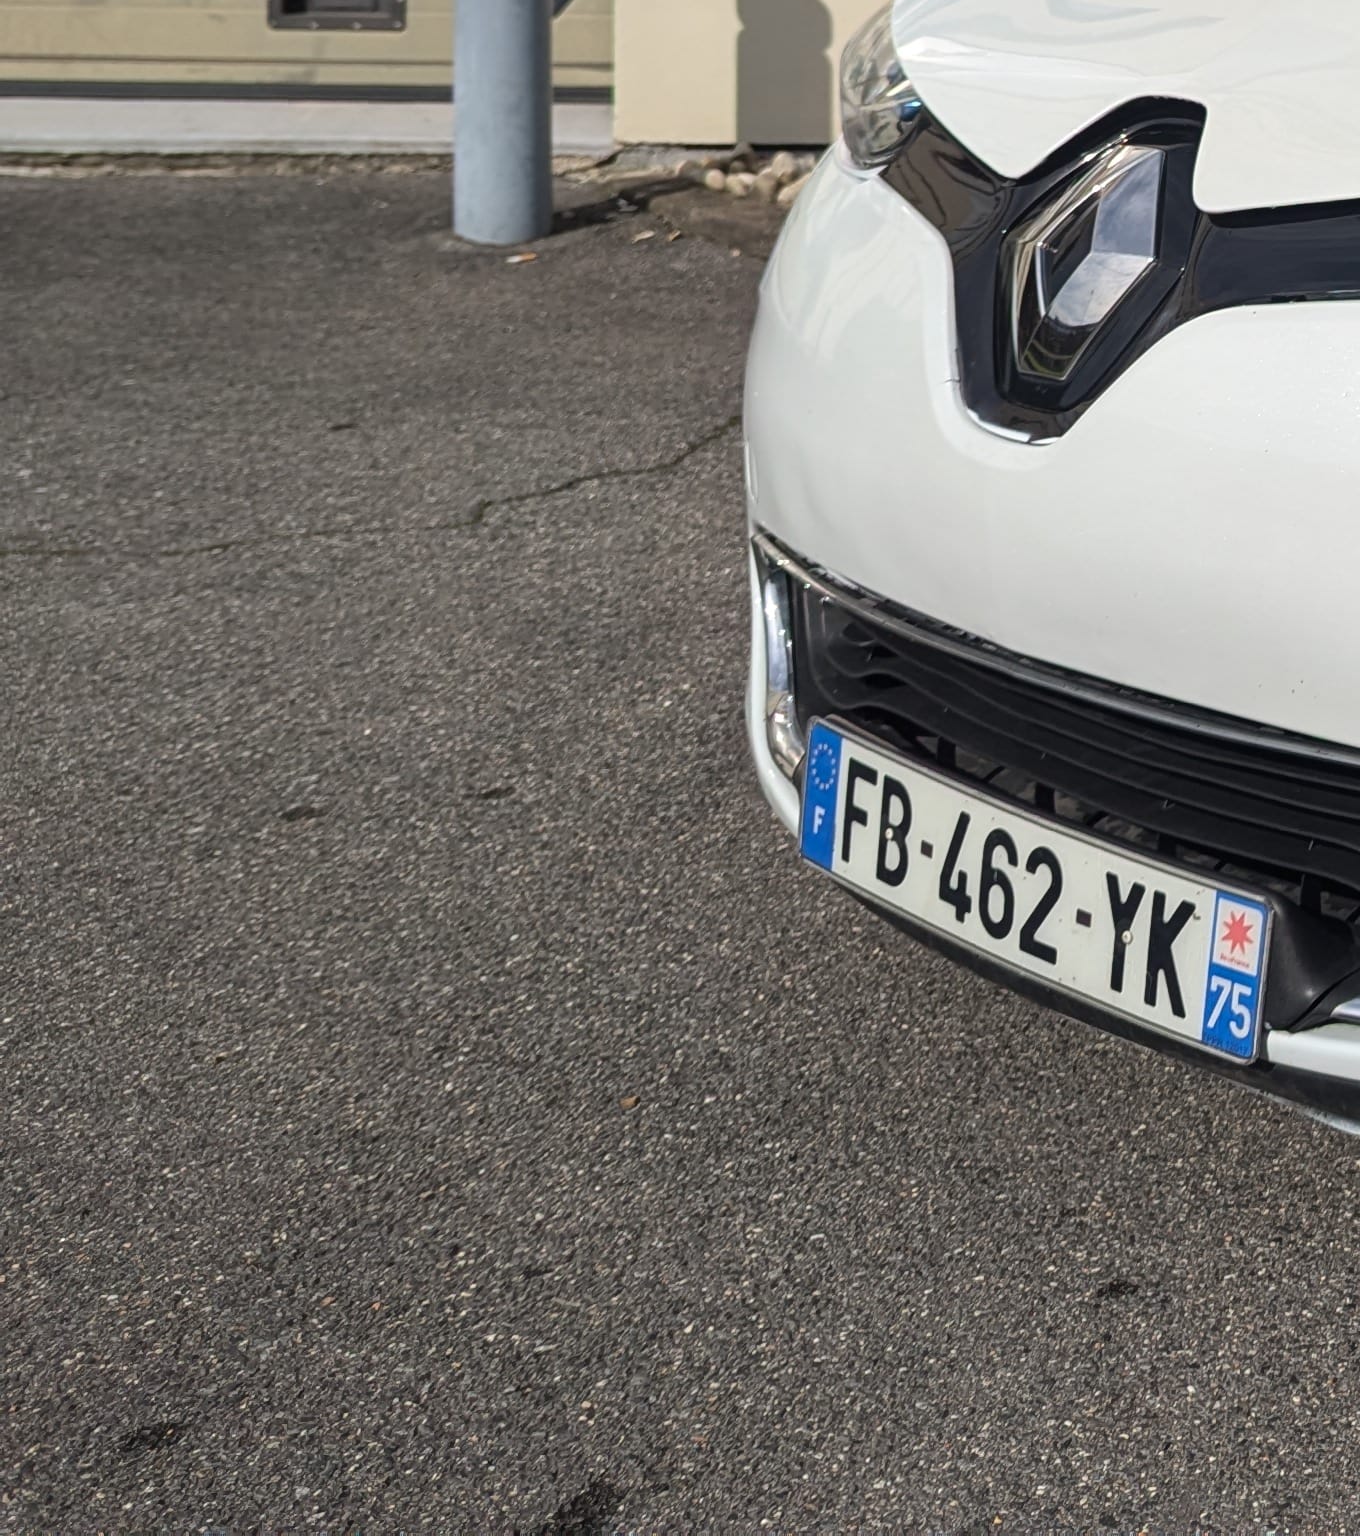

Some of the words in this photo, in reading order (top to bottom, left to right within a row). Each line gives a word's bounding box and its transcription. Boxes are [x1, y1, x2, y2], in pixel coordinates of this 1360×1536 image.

[812, 805, 826, 835] F
[841, 756, 1197, 1019] FB-462-YK
[1207, 974, 1253, 1040] 75
